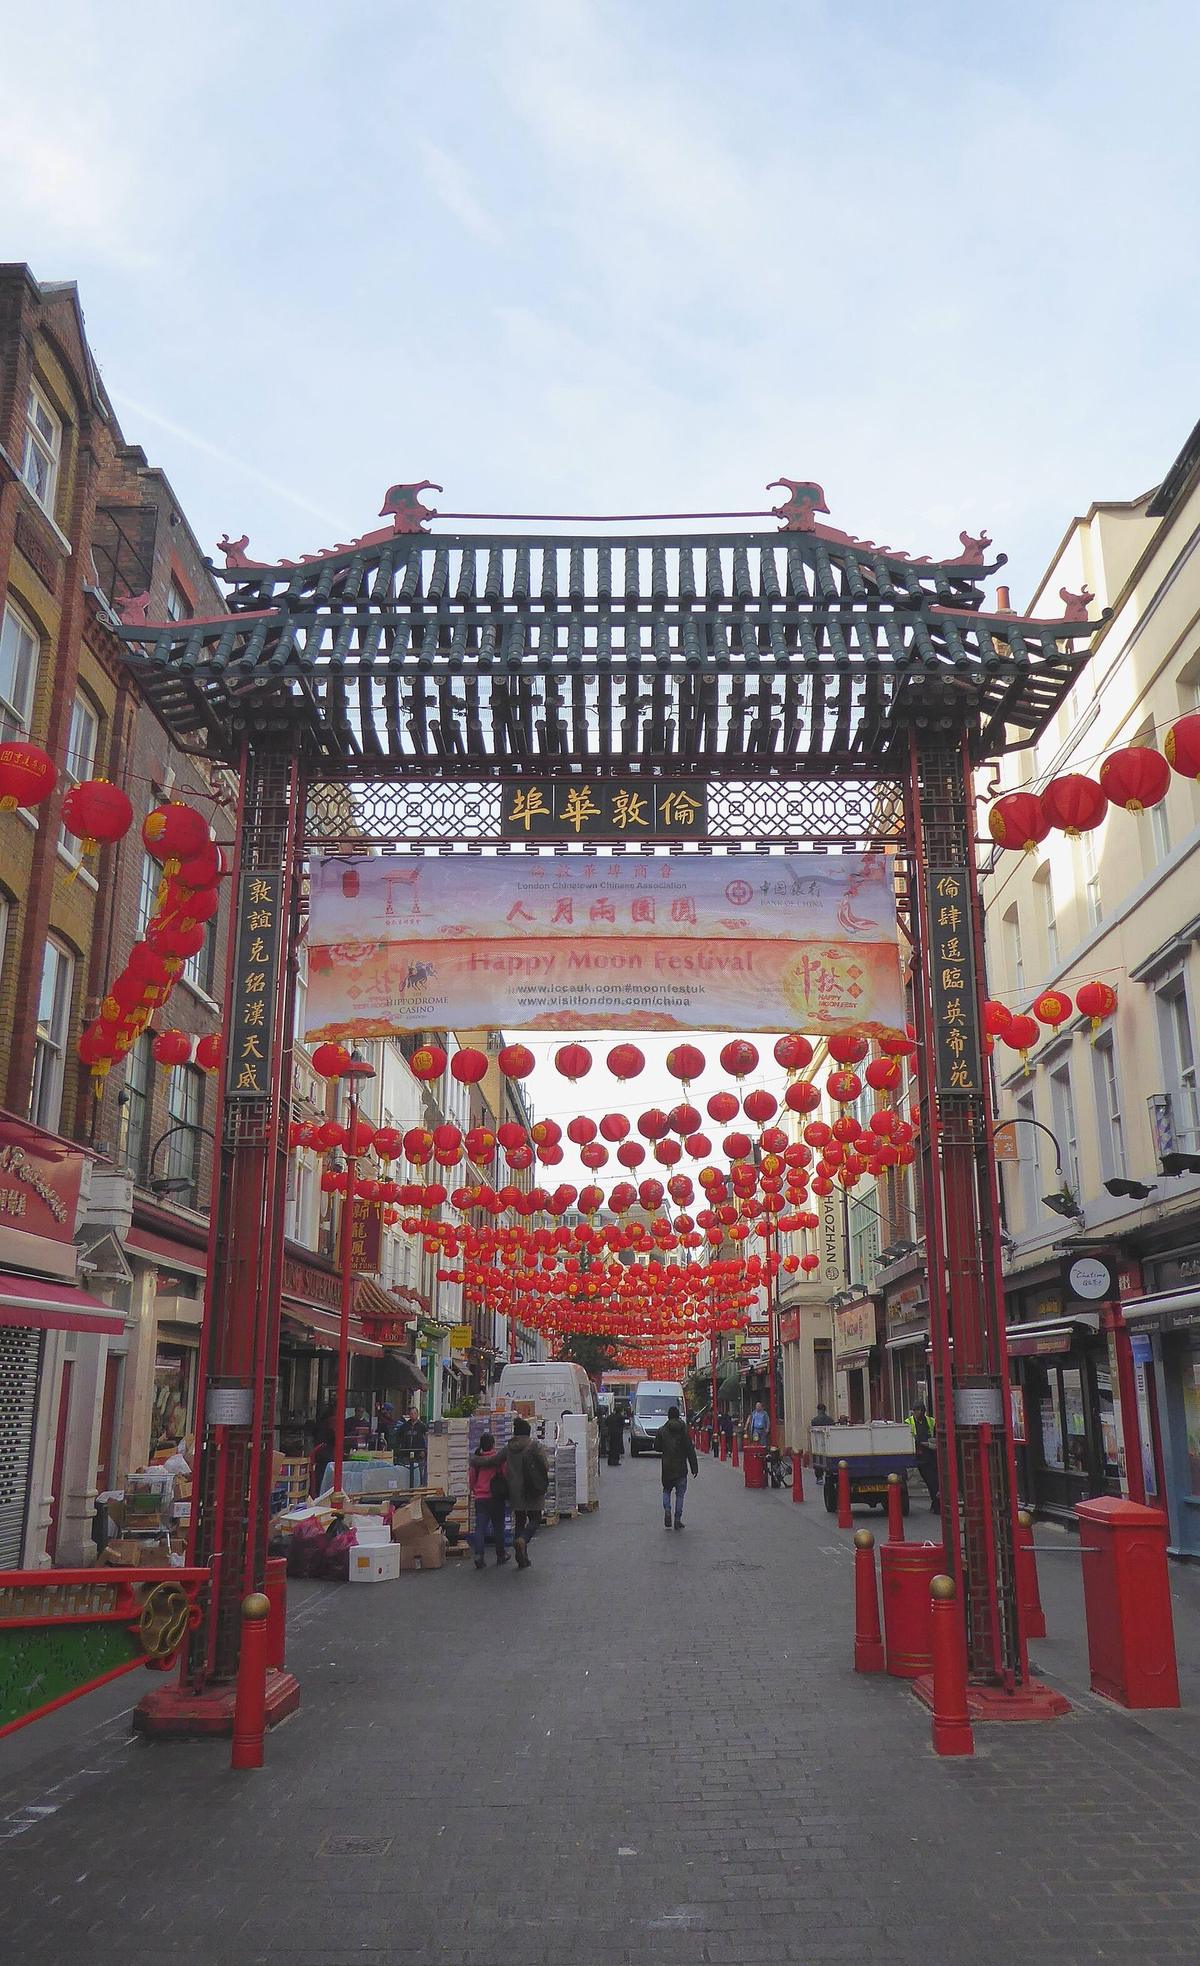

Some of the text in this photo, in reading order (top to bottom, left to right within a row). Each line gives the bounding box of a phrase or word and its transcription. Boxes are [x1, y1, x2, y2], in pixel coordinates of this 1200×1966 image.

[517, 882, 550, 890] London
[471, 950, 753, 976] Happy Moon Festival
[236, 878, 274, 1091] 敦誼克紹漢天威
[385, 996, 449, 1007] HIPPODROME
[517, 995, 691, 1006] www.visitlondon.com/china
[399, 1005, 435, 1014] CASINO
[824, 1195, 837, 1264] HAOZHAN
